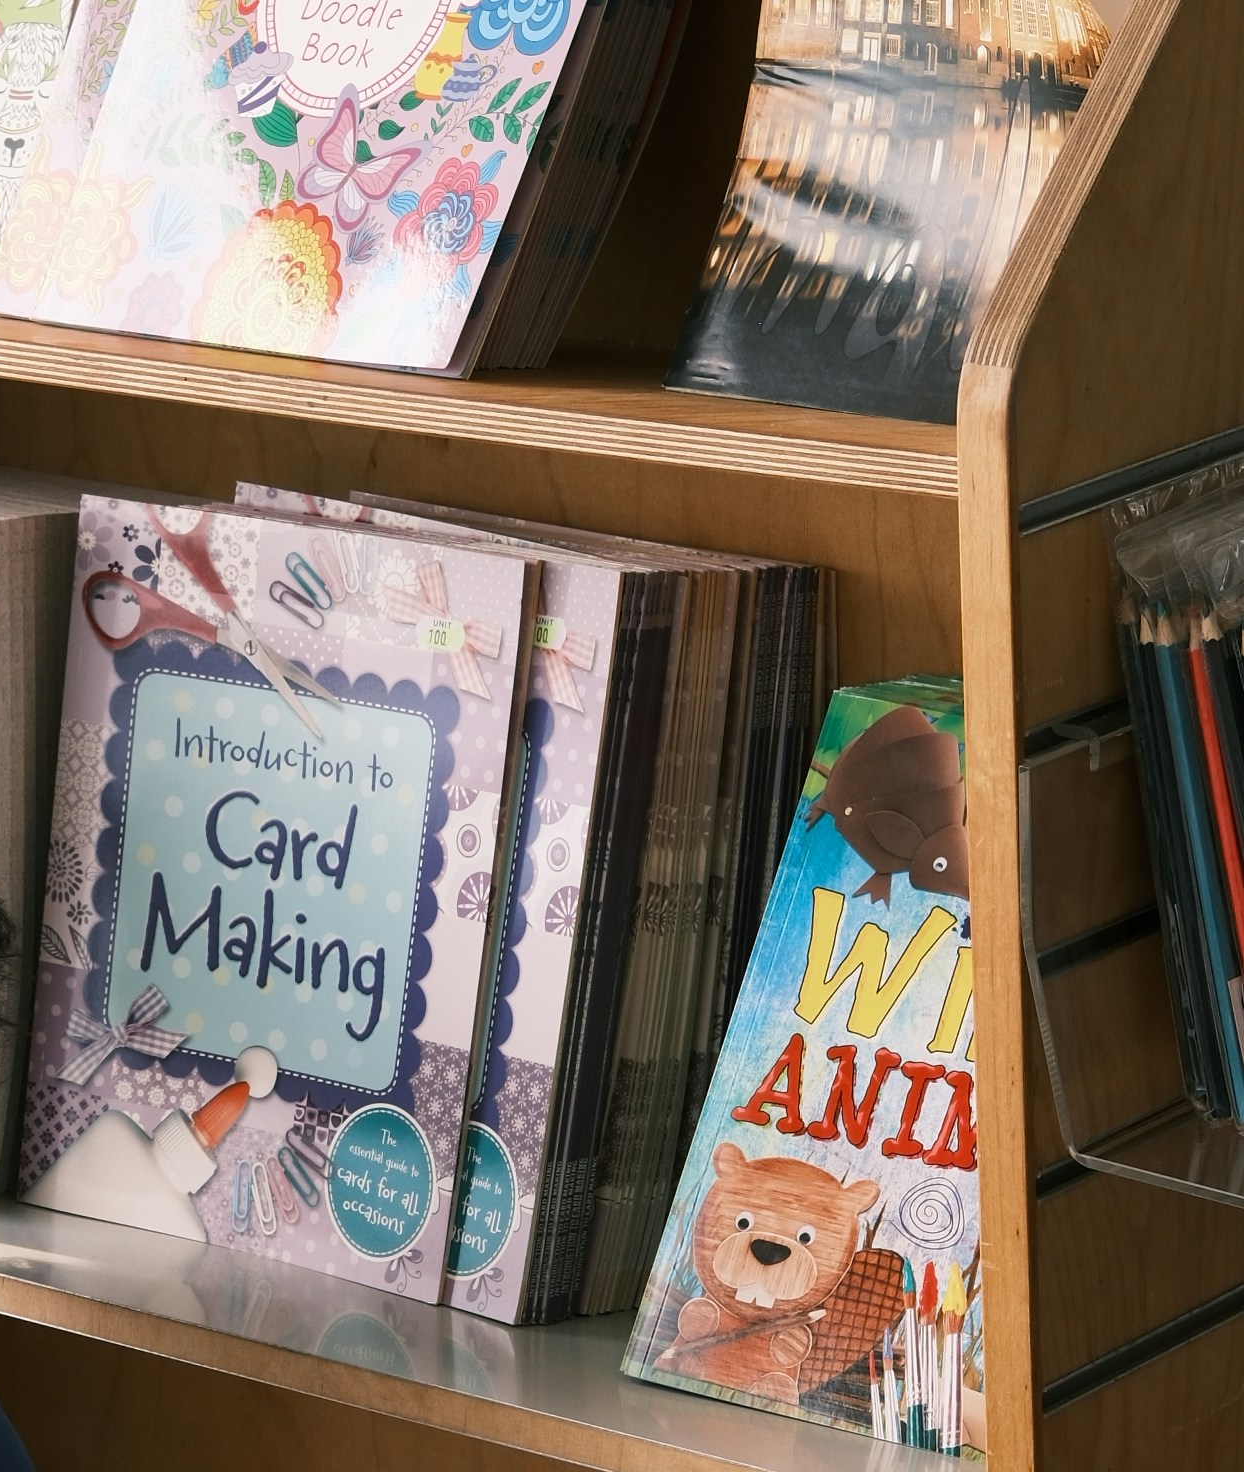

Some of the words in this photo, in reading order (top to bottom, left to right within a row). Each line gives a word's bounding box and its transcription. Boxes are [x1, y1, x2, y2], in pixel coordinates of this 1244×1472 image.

[302, 32, 374, 69] Book
[433, 619, 452, 629] UNIT
[174, 717, 354, 784] Introduction
[367, 753, 394, 792] to
[205, 790, 358, 889] Card
[140, 871, 385, 1041] Making
[380, 1128, 397, 1147] The
[467, 1145, 482, 1165] The
[348, 1145, 384, 1165] essential
[385, 1159, 408, 1174] guide
[411, 1164, 420, 1178] to
[543, 1160, 552, 1196] MAKING
[553, 1160, 562, 1196] MAKING
[563, 1162, 572, 1196] MAKING
[569, 1160, 577, 1195] MAKING
[589, 1156, 599, 1191] MAKING
[337, 1166, 373, 1195] cards
[377, 1177, 397, 1203] for
[470, 1176, 492, 1191] guide
[494, 1181, 503, 1196] to
[342, 1199, 405, 1236] occasions
[461, 1194, 479, 1221] for
